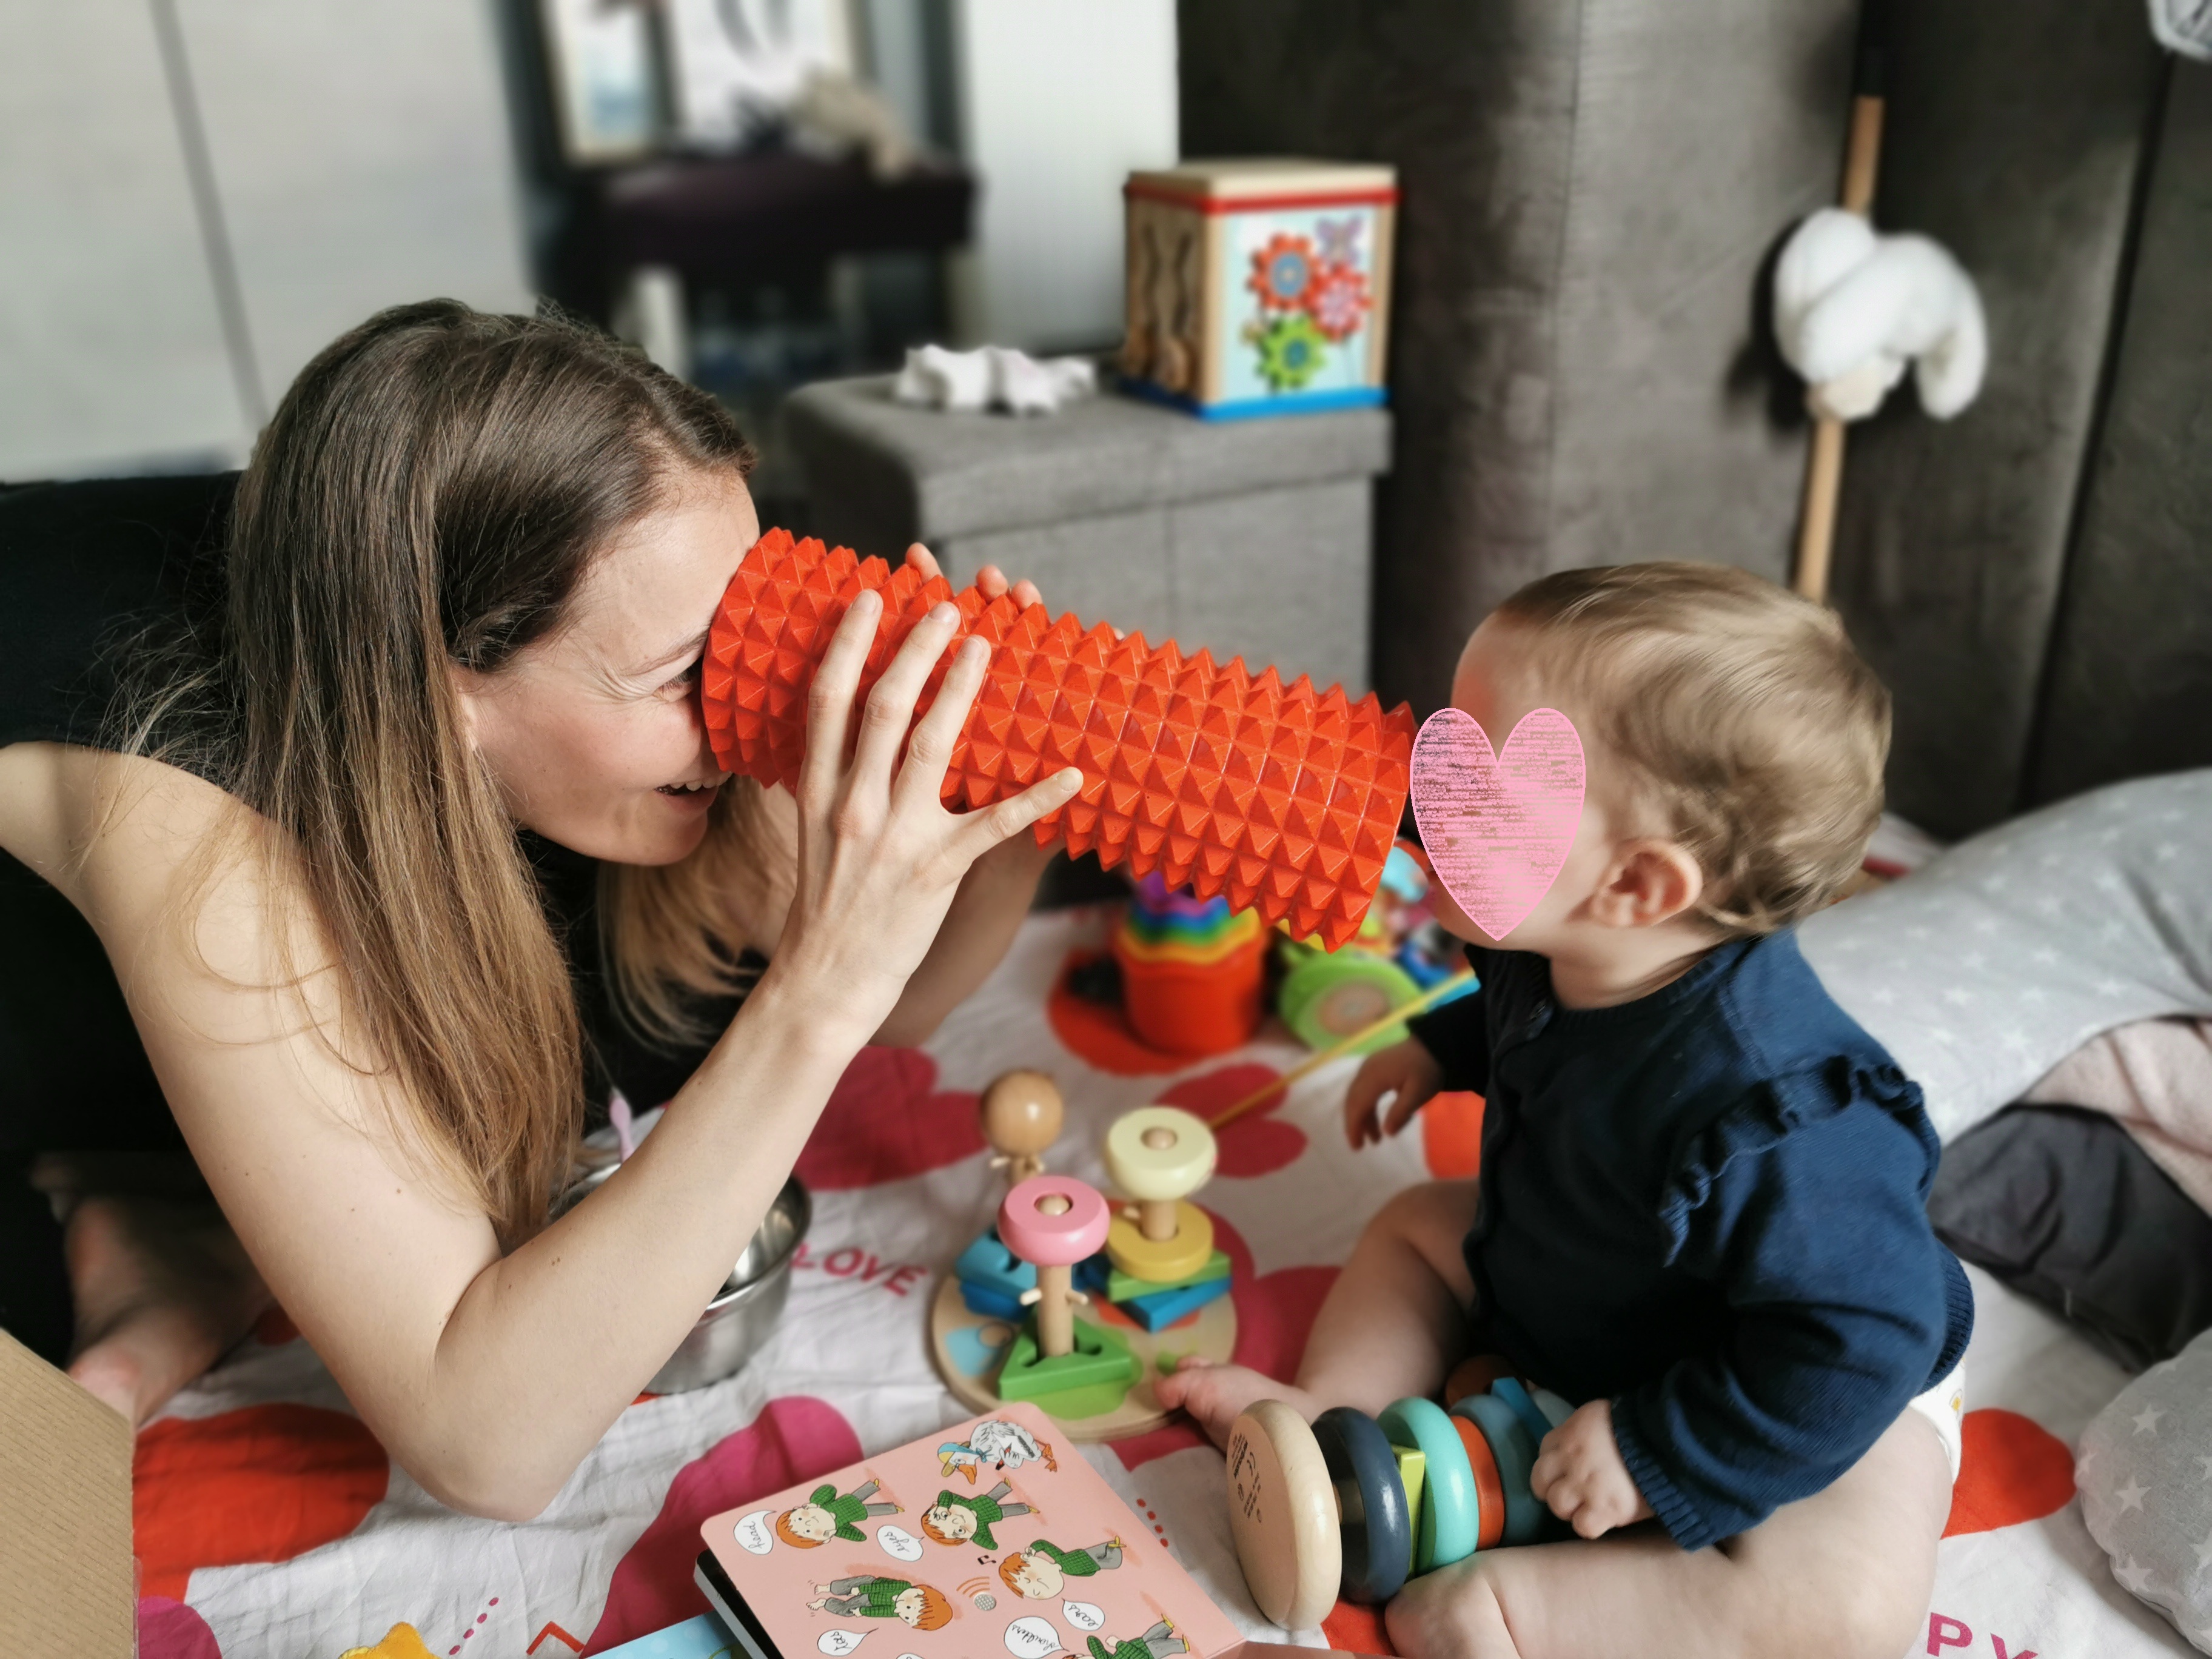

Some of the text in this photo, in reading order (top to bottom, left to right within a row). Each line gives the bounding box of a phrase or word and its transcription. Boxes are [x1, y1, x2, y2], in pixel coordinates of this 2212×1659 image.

[791, 1243, 928, 1296] LOVE
[743, 1520, 765, 1549] head
[884, 1531, 910, 1552] eyes
[1068, 1604, 1099, 1627] ears
[830, 1631, 853, 1651] toes
[1011, 1624, 1059, 1651] shoulders
